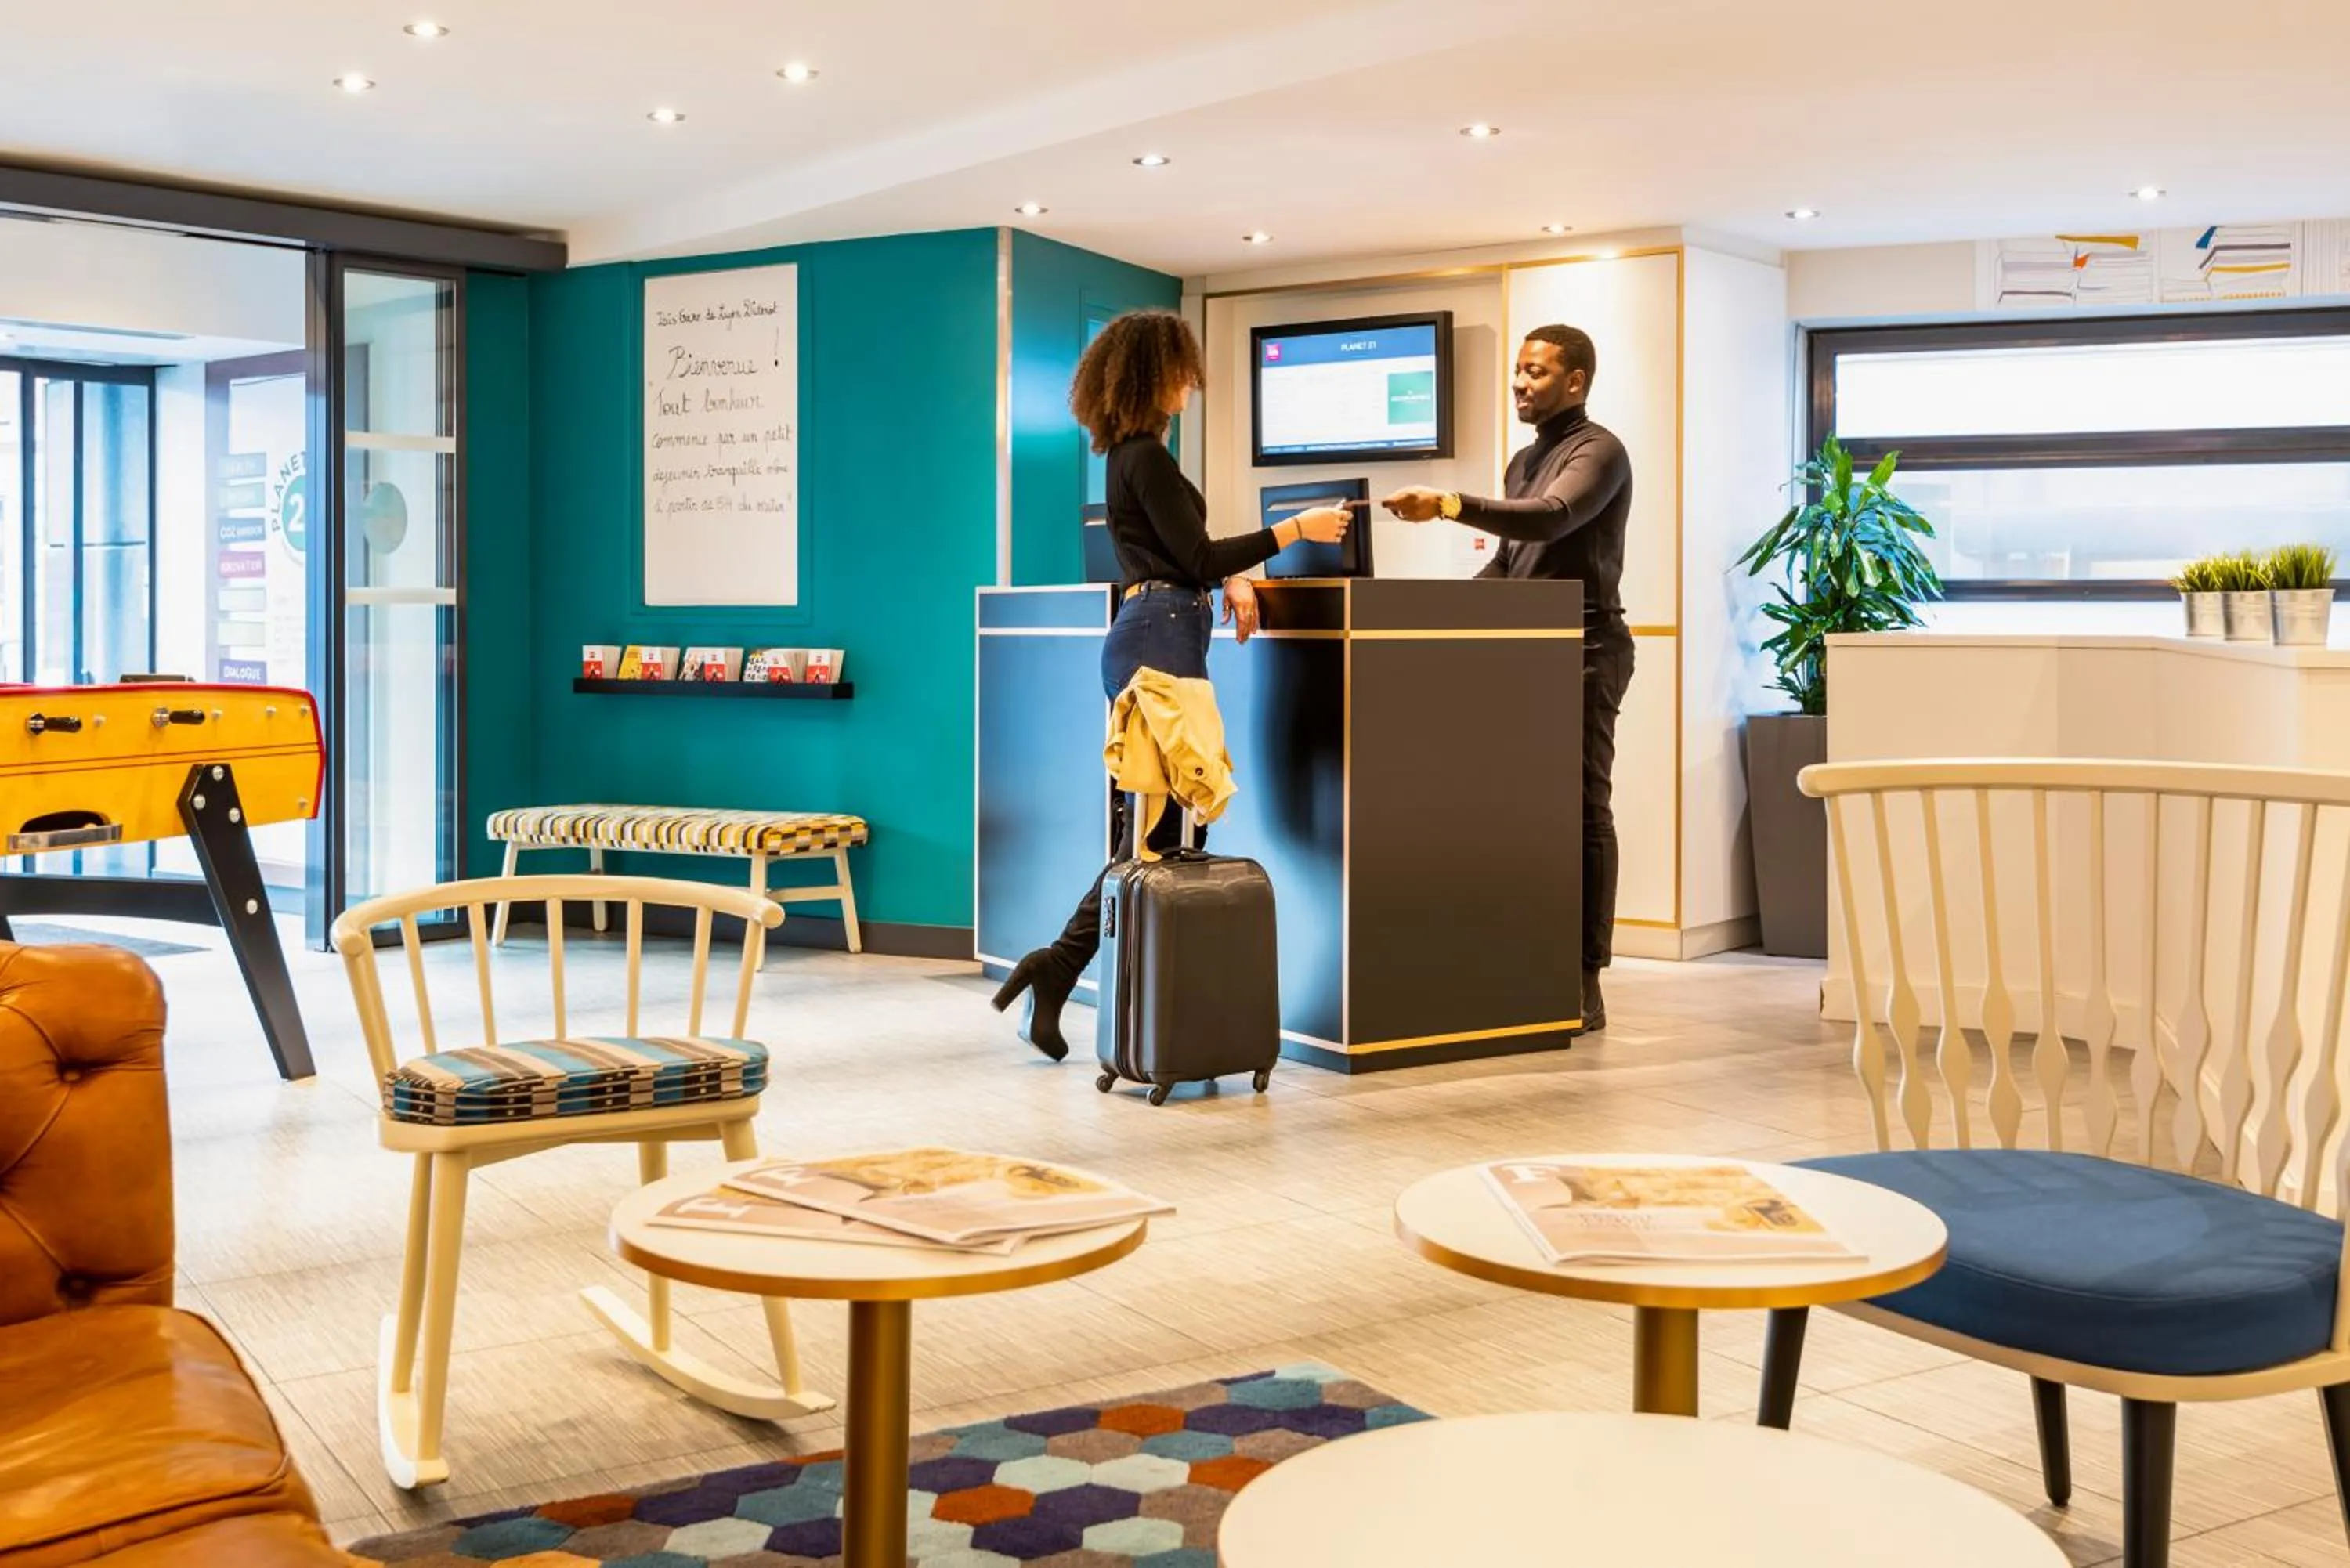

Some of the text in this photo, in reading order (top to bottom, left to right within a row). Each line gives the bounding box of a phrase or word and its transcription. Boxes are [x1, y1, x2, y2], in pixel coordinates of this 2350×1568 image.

[667, 345, 758, 378] Bienvenue
[653, 387, 692, 417] Tout
[742, 432, 757, 443] un
